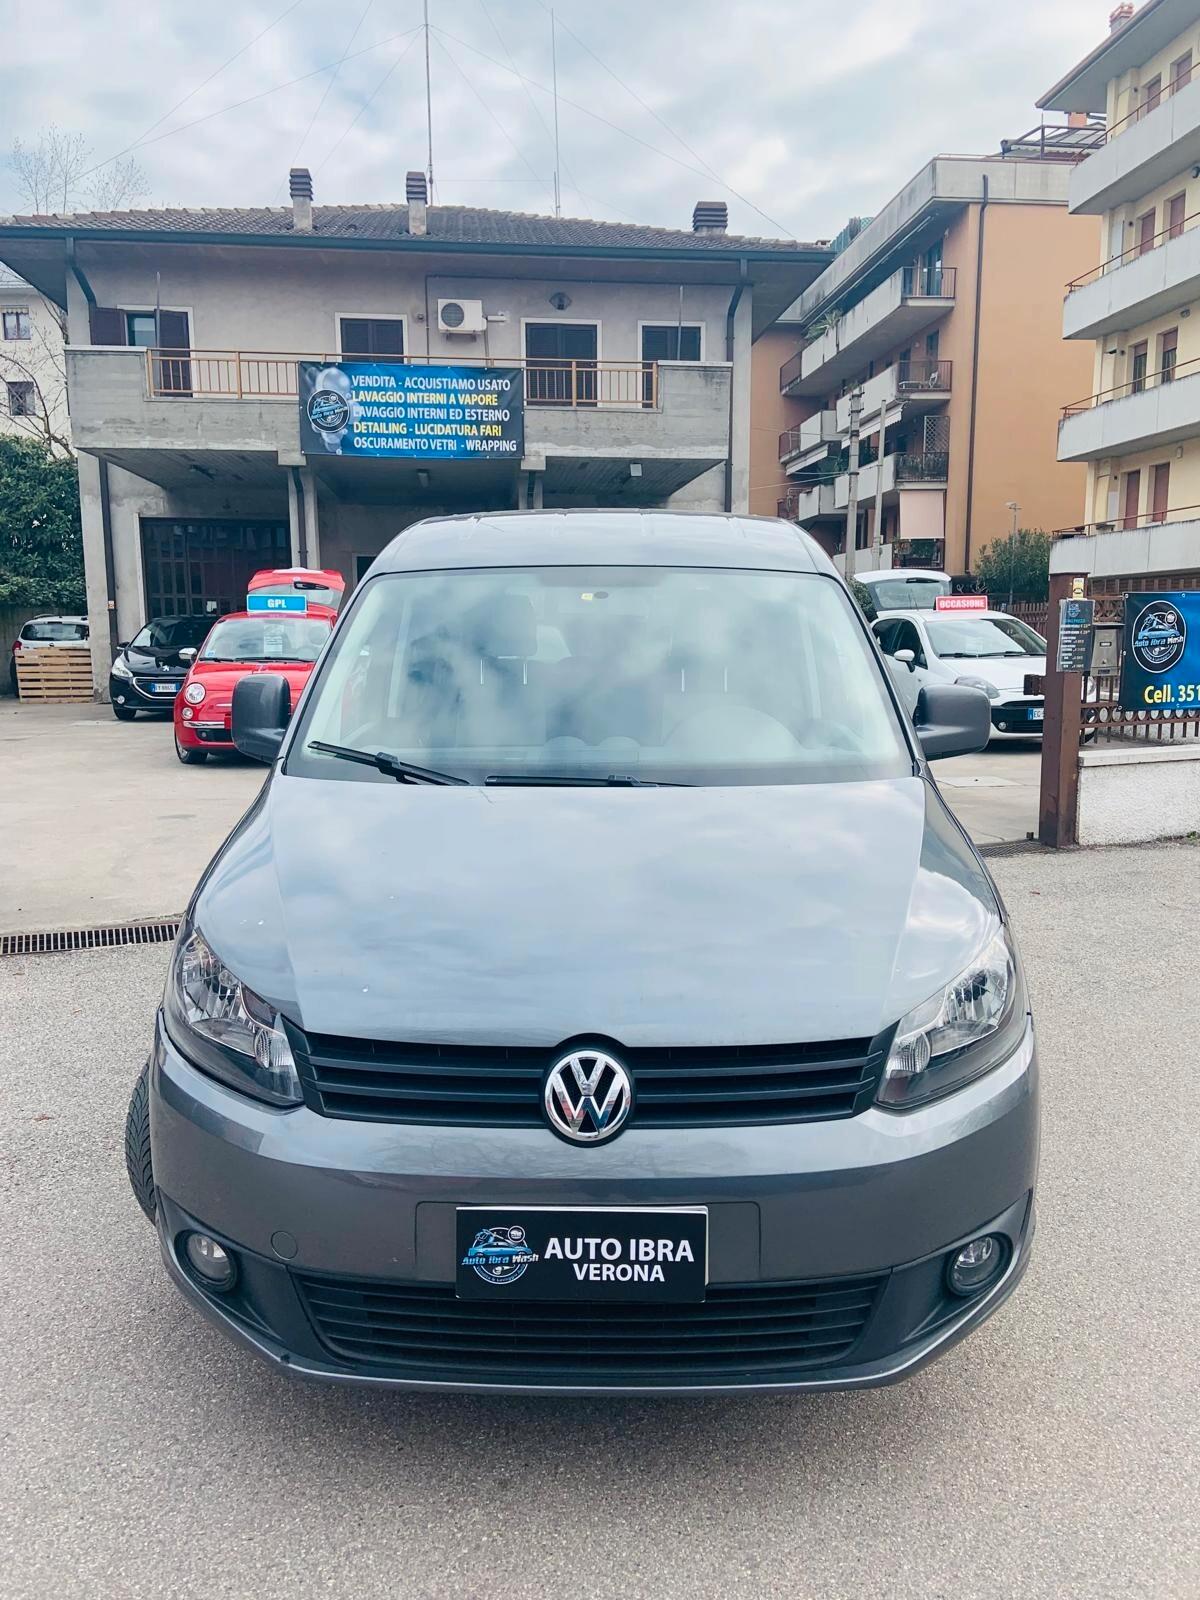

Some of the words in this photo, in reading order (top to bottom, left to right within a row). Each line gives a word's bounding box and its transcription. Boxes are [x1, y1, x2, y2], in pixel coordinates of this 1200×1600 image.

[351, 375, 397, 388] VENDITA
[404, 376, 476, 391] ACQUISTIAMO
[477, 379, 511, 391] USATO
[352, 390, 405, 403] LAVAGGIO
[406, 392, 447, 405] INTERNI
[449, 393, 457, 405] A
[458, 393, 498, 406] VAPORE
[352, 406, 406, 418] LAVAGGIO
[407, 407, 447, 420] INTERNI
[449, 408, 463, 420] ED
[464, 409, 510, 422] ESTERNO
[353, 421, 407, 434] DETAILING
[414, 423, 478, 436] LUCIDATURA
[480, 425, 502, 437] FARI
[353, 436, 429, 450] OSCURAMENTO
[429, 438, 457, 451] VETRI
[465, 440, 517, 452] WRAPPING
[267, 598, 287, 608] GPL
[939, 599, 985, 609] OCCASIONE
[1144, 684, 1176, 704] Cell.
[544, 1237, 623, 1261] AUTO
[629, 1238, 694, 1263] IBRA
[461, 1256, 486, 1266] Auto
[488, 1255, 510, 1264] Ibra
[511, 1253, 539, 1264] Wash
[573, 1263, 665, 1282] VERONA
